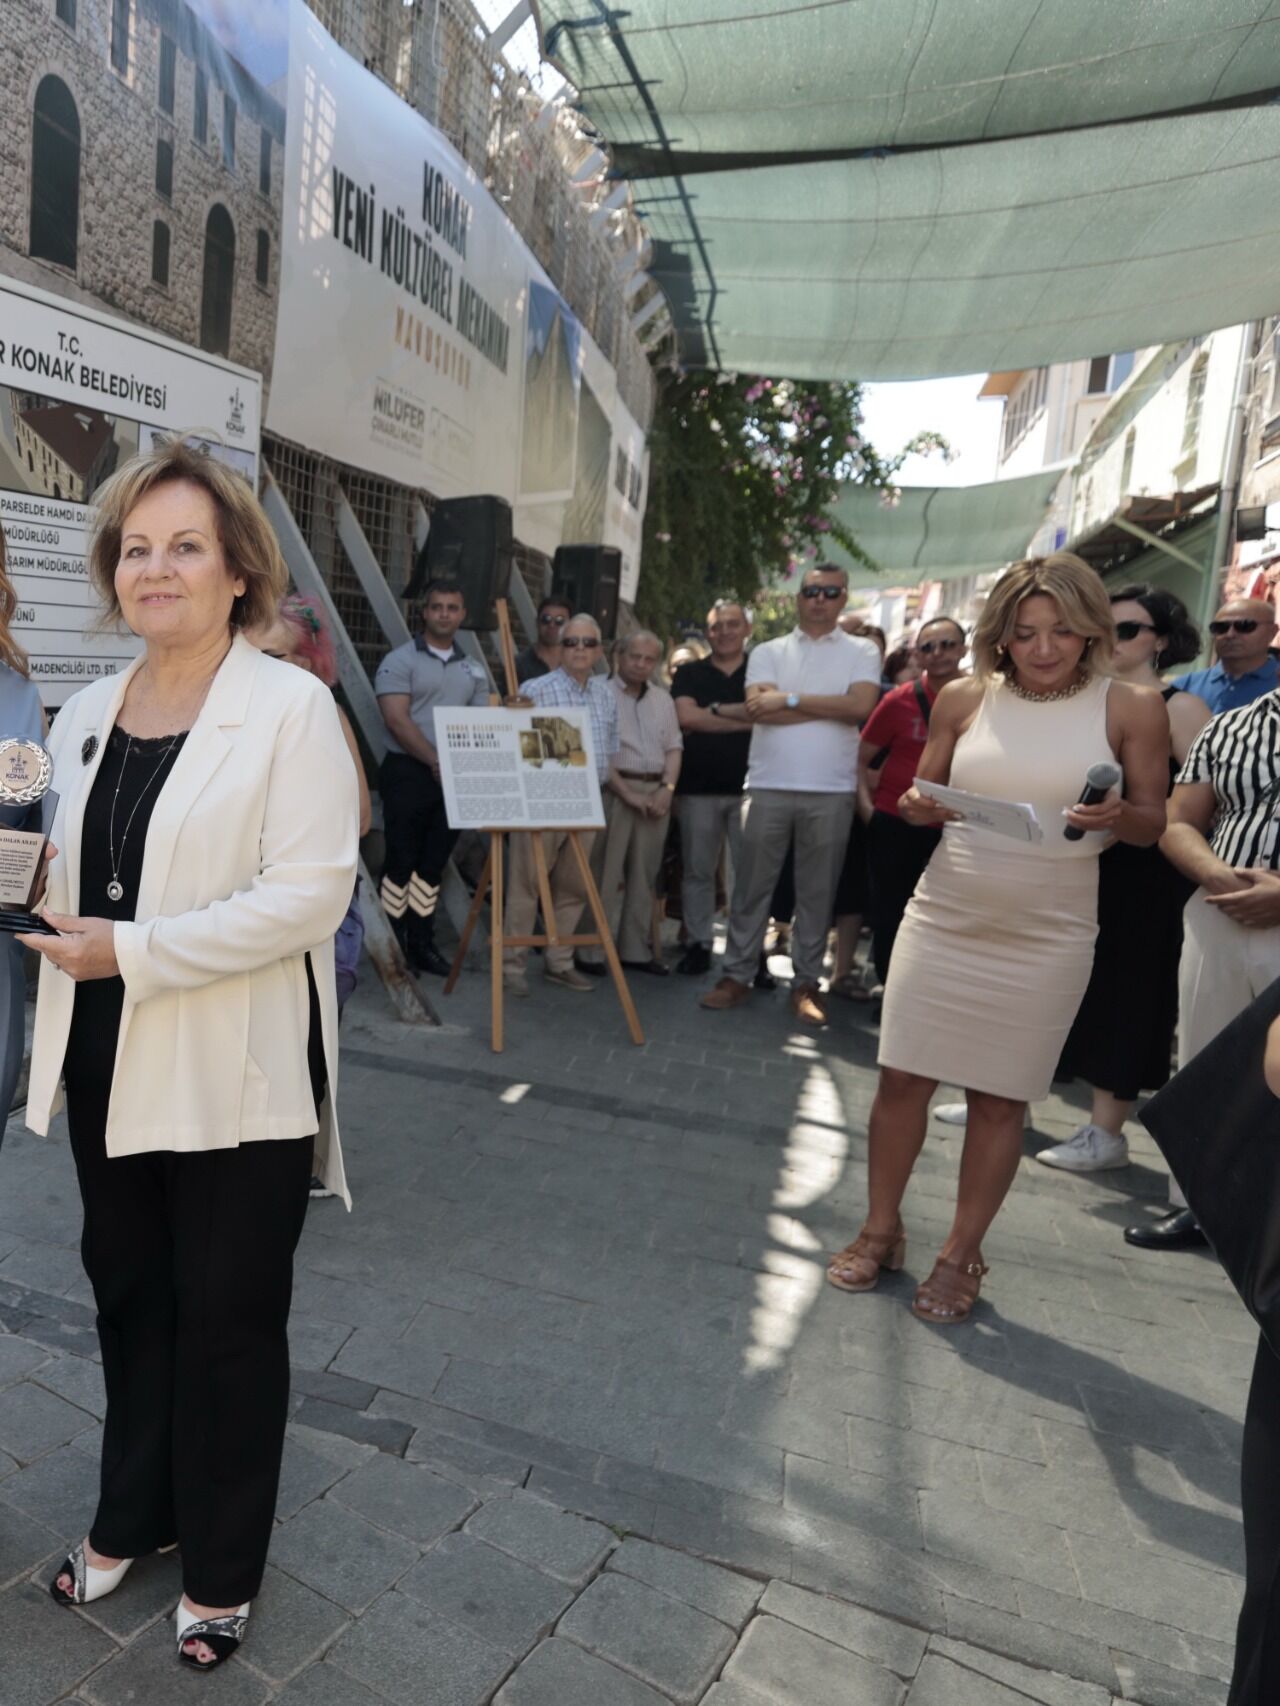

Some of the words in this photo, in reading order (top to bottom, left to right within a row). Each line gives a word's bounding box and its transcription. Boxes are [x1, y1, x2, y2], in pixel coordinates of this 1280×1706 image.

[423, 160, 470, 262] KONAK
[332, 165, 375, 264] YENİ
[380, 205, 453, 325] KÜLTÜREL
[57, 331, 83, 357] T.C.
[11, 343, 75, 384] KONAK
[80, 364, 167, 411] BELEDİYESİ
[1, 499, 45, 516] PARSELDE
[47, 505, 75, 522] HAMDİ
[6, 555, 34, 569] SARIM
[14, 608, 36, 622] ÜNÜ
